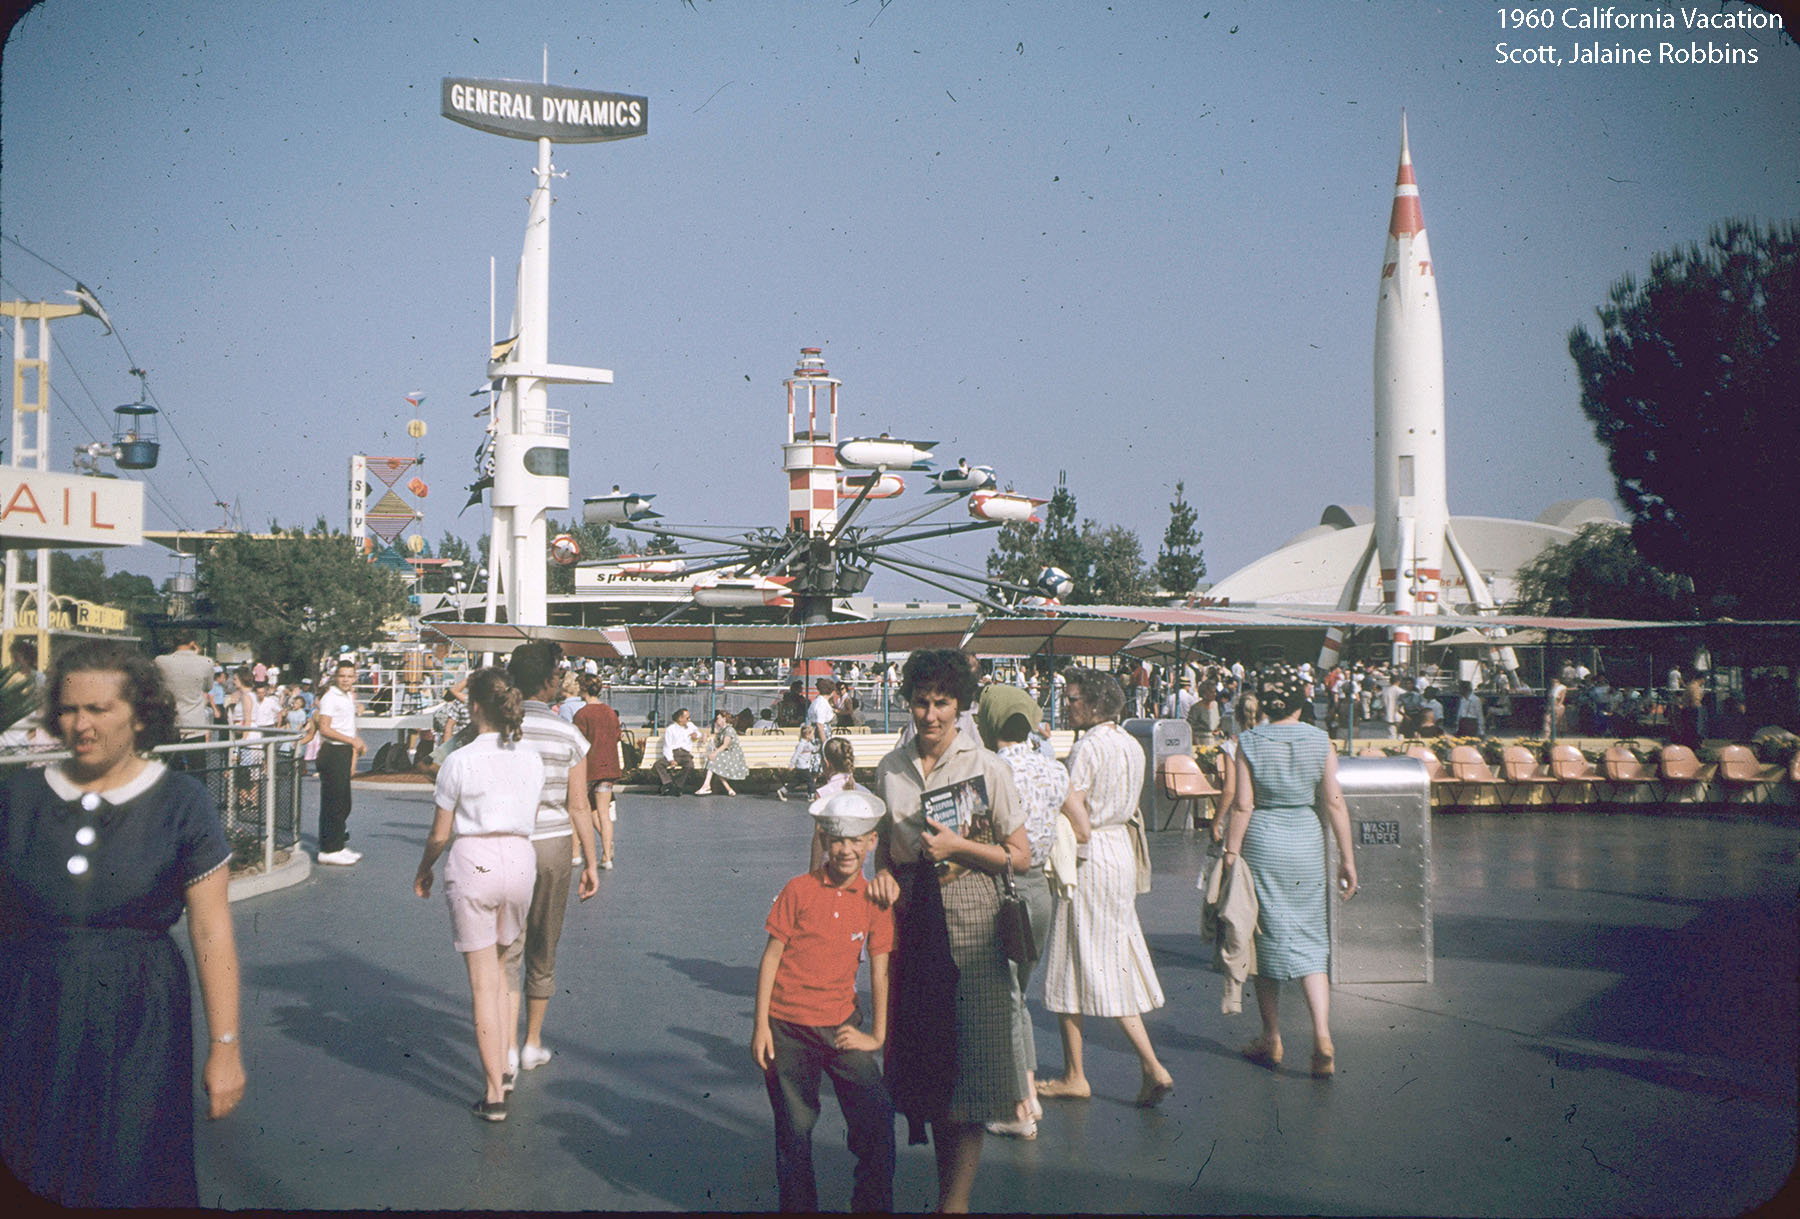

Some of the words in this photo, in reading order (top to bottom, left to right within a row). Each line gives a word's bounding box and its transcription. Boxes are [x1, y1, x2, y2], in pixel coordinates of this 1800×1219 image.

[451, 84, 535, 120] GENERAL
[542, 97, 641, 127] DYNAMICS
[1362, 822, 1398, 833] WASTE
[1363, 833, 1397, 844] PAPER
